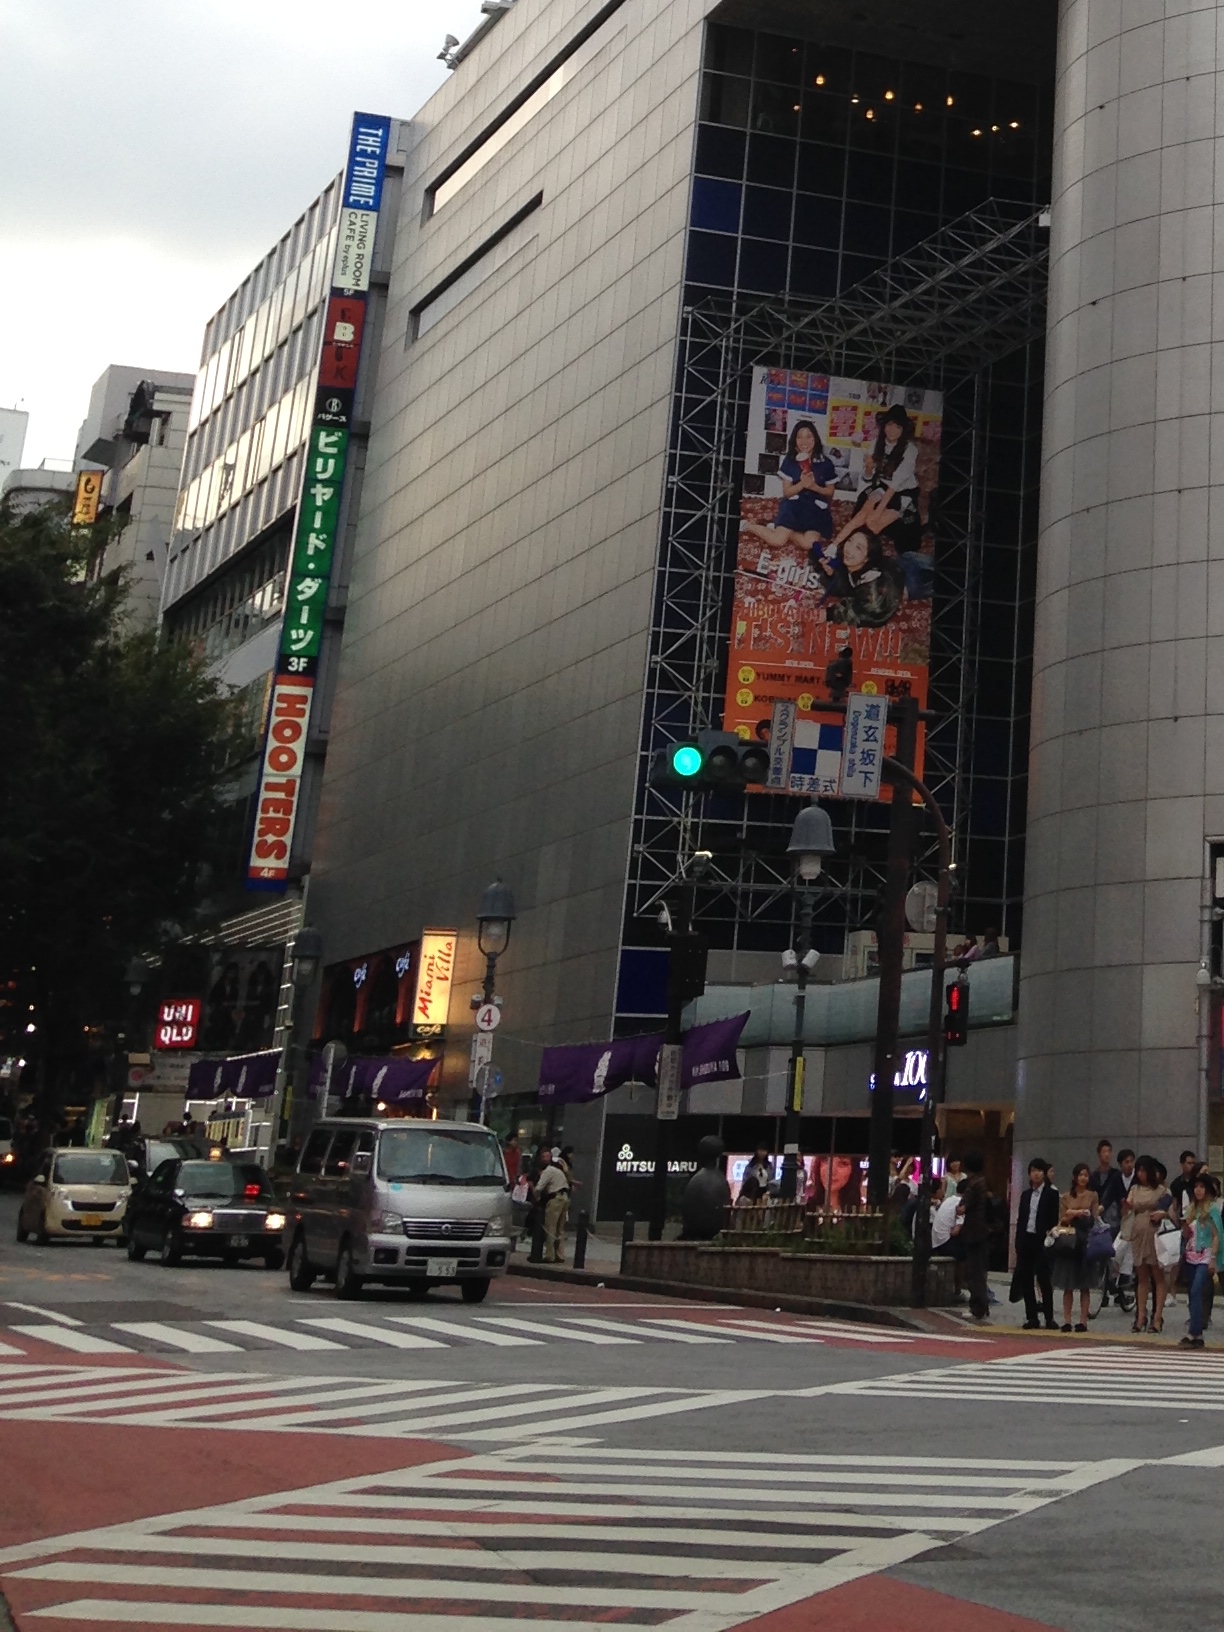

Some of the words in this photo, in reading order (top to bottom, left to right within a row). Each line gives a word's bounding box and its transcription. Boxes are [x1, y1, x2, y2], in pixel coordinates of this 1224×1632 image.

[356, 127, 383, 155] THE
[349, 156, 379, 206] PRIME
[345, 211, 358, 242] CAFE
[356, 213, 370, 250] LIVING
[352, 253, 365, 287] ROOM
[290, 431, 342, 651] ビリヤード・ダーツ
[757, 551, 821, 589] E-girls
[287, 656, 309, 672] 3F
[859, 703, 881, 788] 道玄坂下
[254, 693, 309, 861] HOOTERS
[260, 867, 276, 879] 4F
[436, 941, 453, 982] Villa
[418, 954, 435, 1019] Miami
[163, 1004, 193, 1021] UNI
[481, 1008, 493, 1026] 4
